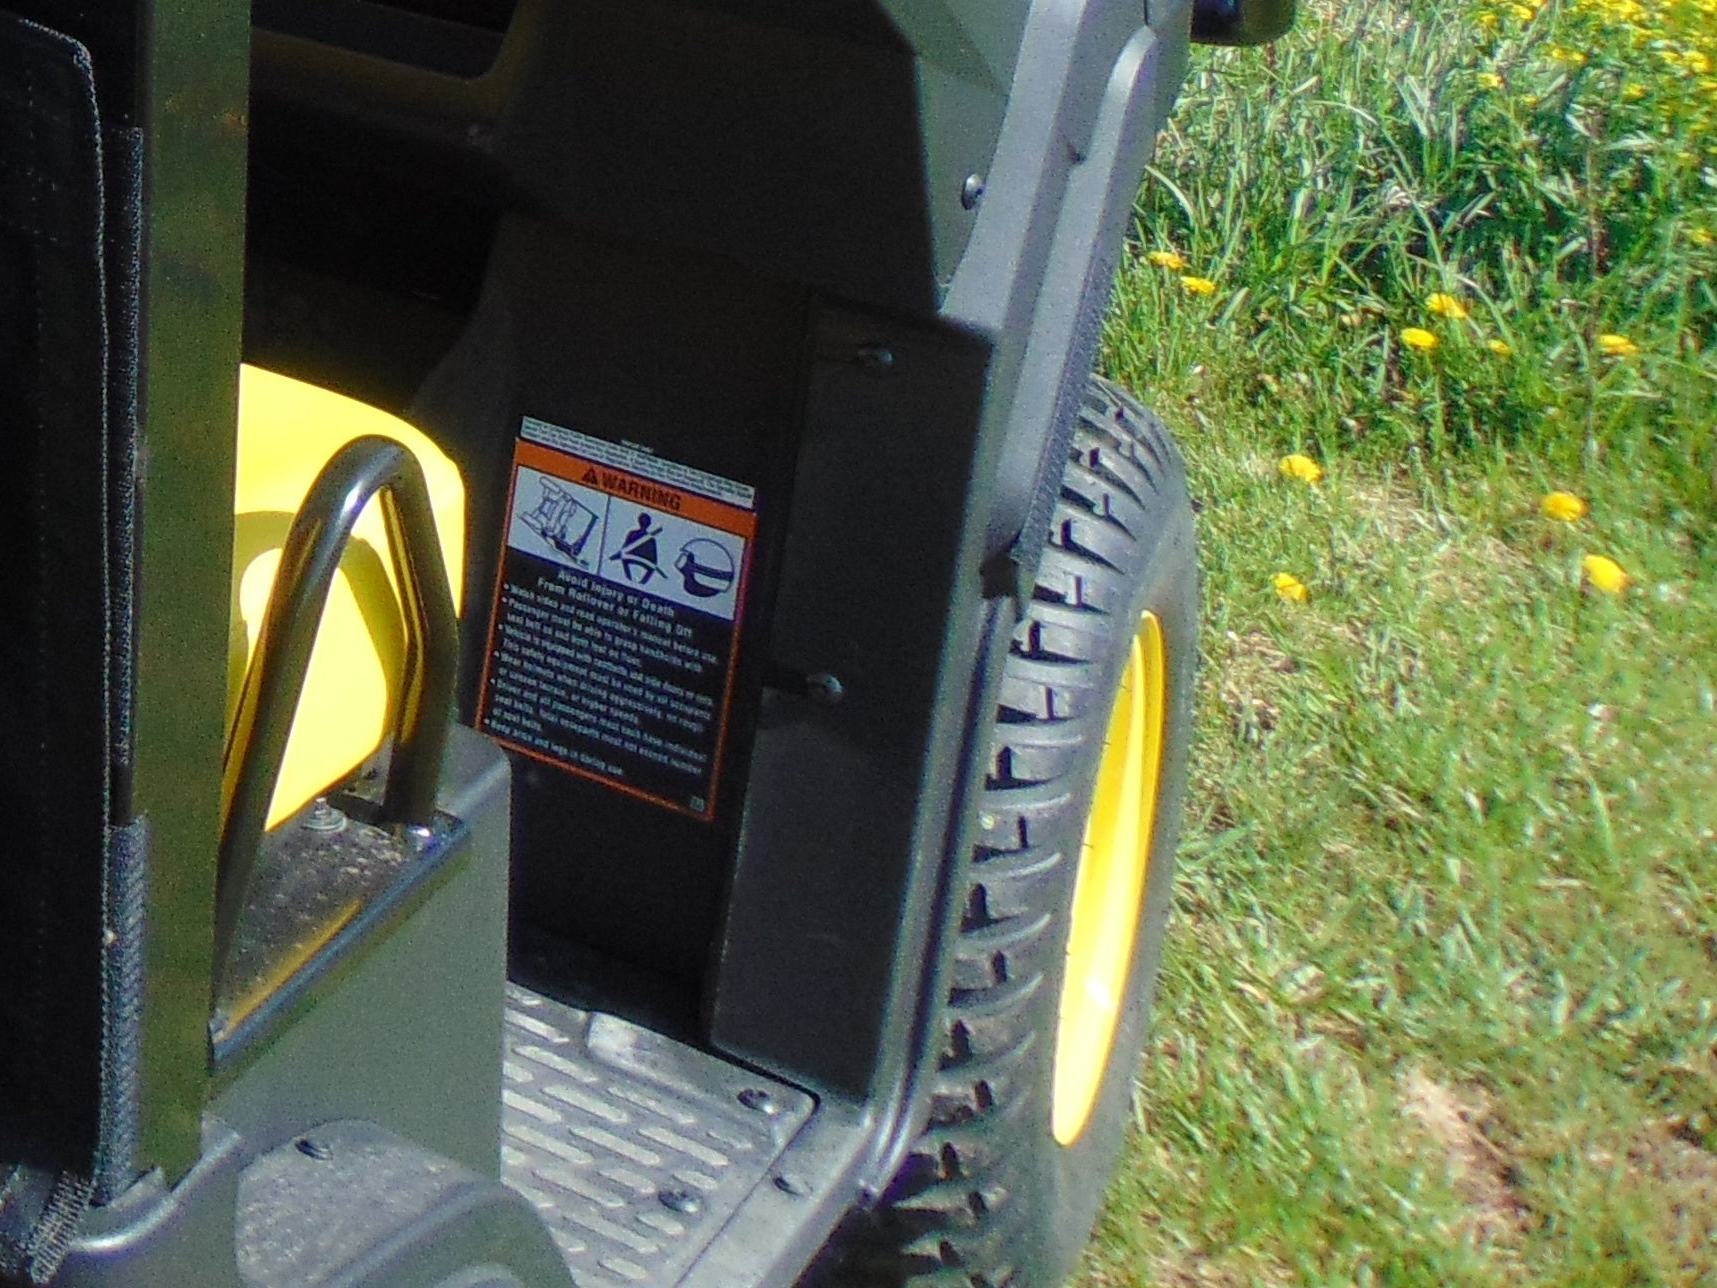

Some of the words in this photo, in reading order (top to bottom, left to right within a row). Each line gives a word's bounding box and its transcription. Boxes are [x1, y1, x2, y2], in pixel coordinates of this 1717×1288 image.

[601, 471, 681, 512] WARNING
[538, 577, 565, 595] From
[569, 588, 614, 611] Rollover
[618, 607, 629, 616] or
[633, 610, 671, 633] Falling
[676, 624, 692, 637] Off
[558, 570, 588, 588] Avoid
[591, 582, 624, 601] Injury
[627, 596, 638, 605] or
[642, 598, 674, 617] Death
